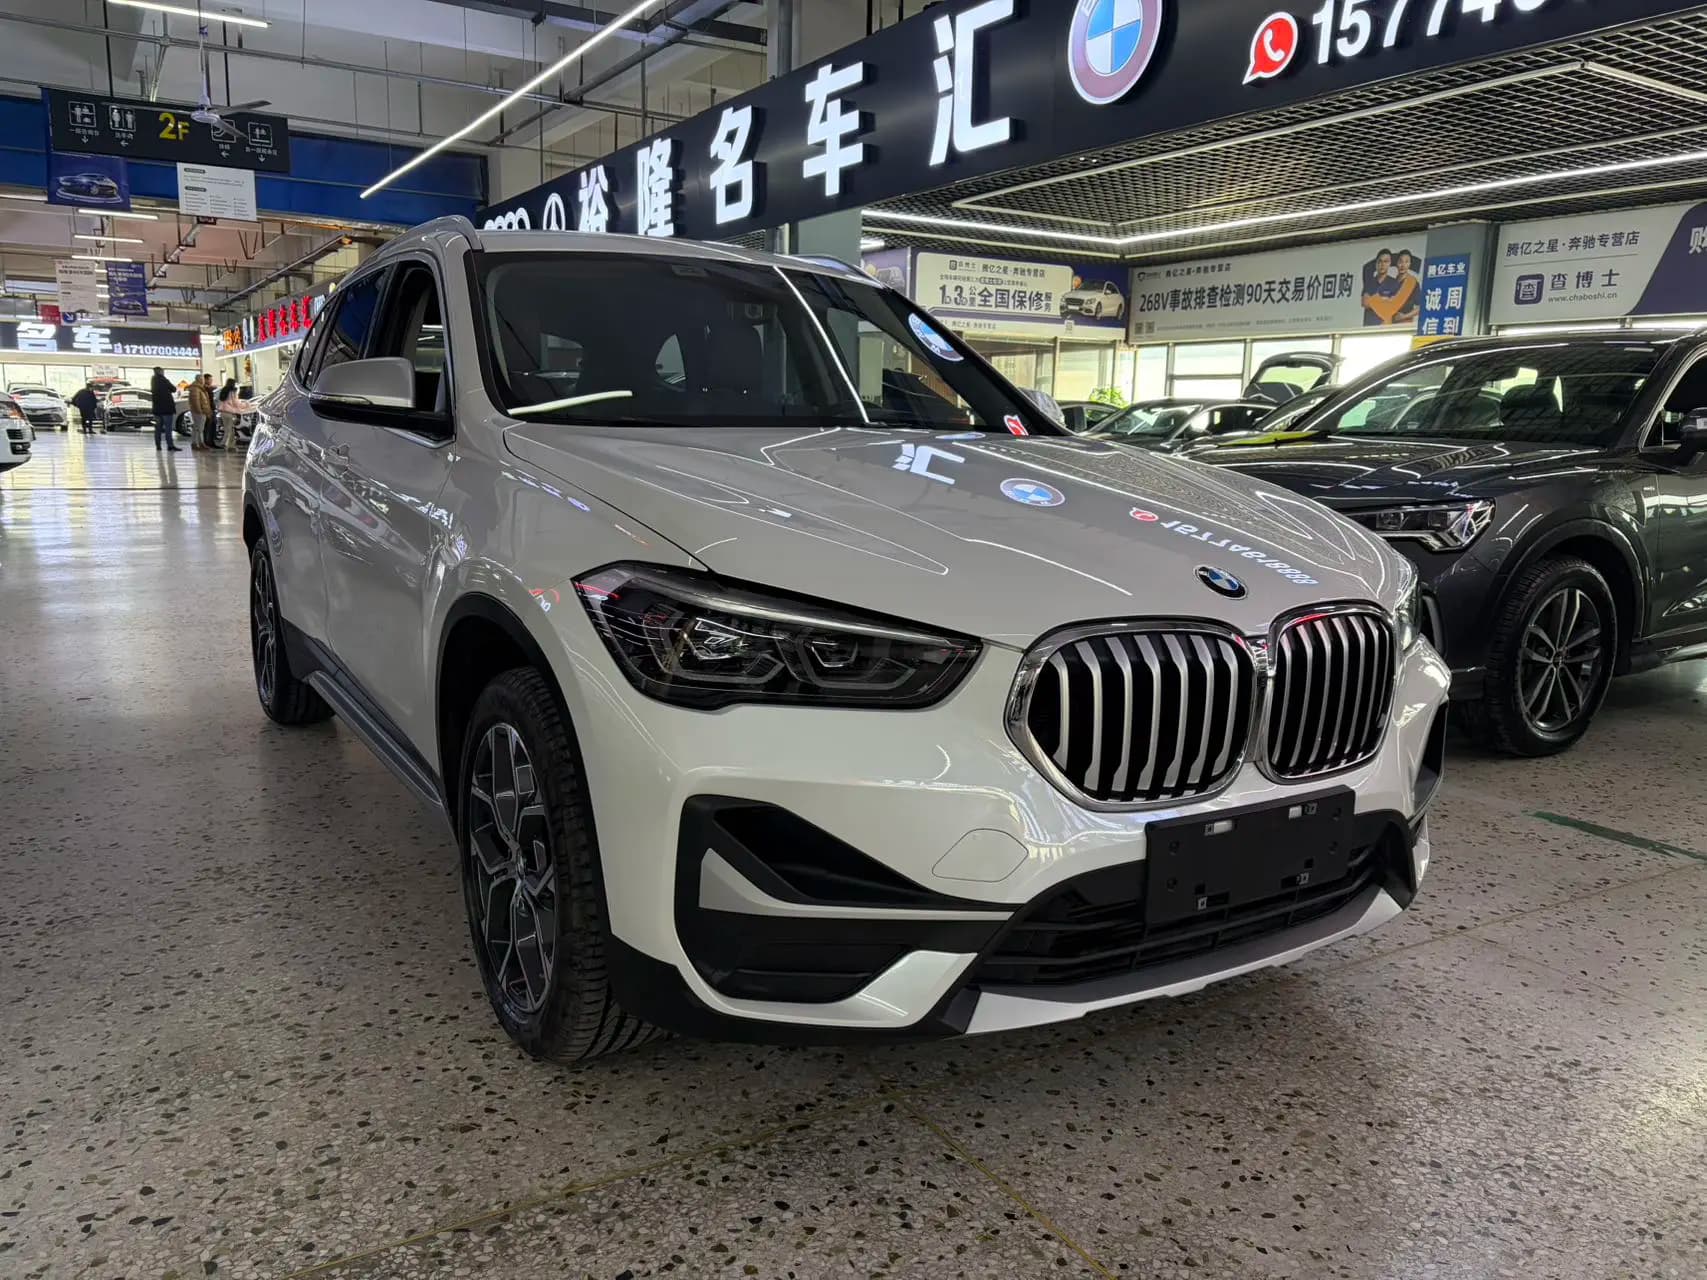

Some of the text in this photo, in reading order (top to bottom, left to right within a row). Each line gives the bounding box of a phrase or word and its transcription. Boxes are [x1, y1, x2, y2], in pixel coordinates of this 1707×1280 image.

[1312, 0, 1546, 65] 1577
[159, 112, 190, 140] 2F
[579, 0, 1014, 237] 裕隆名车汇
[1548, 292, 1618, 303] www.chaboshi.cn
